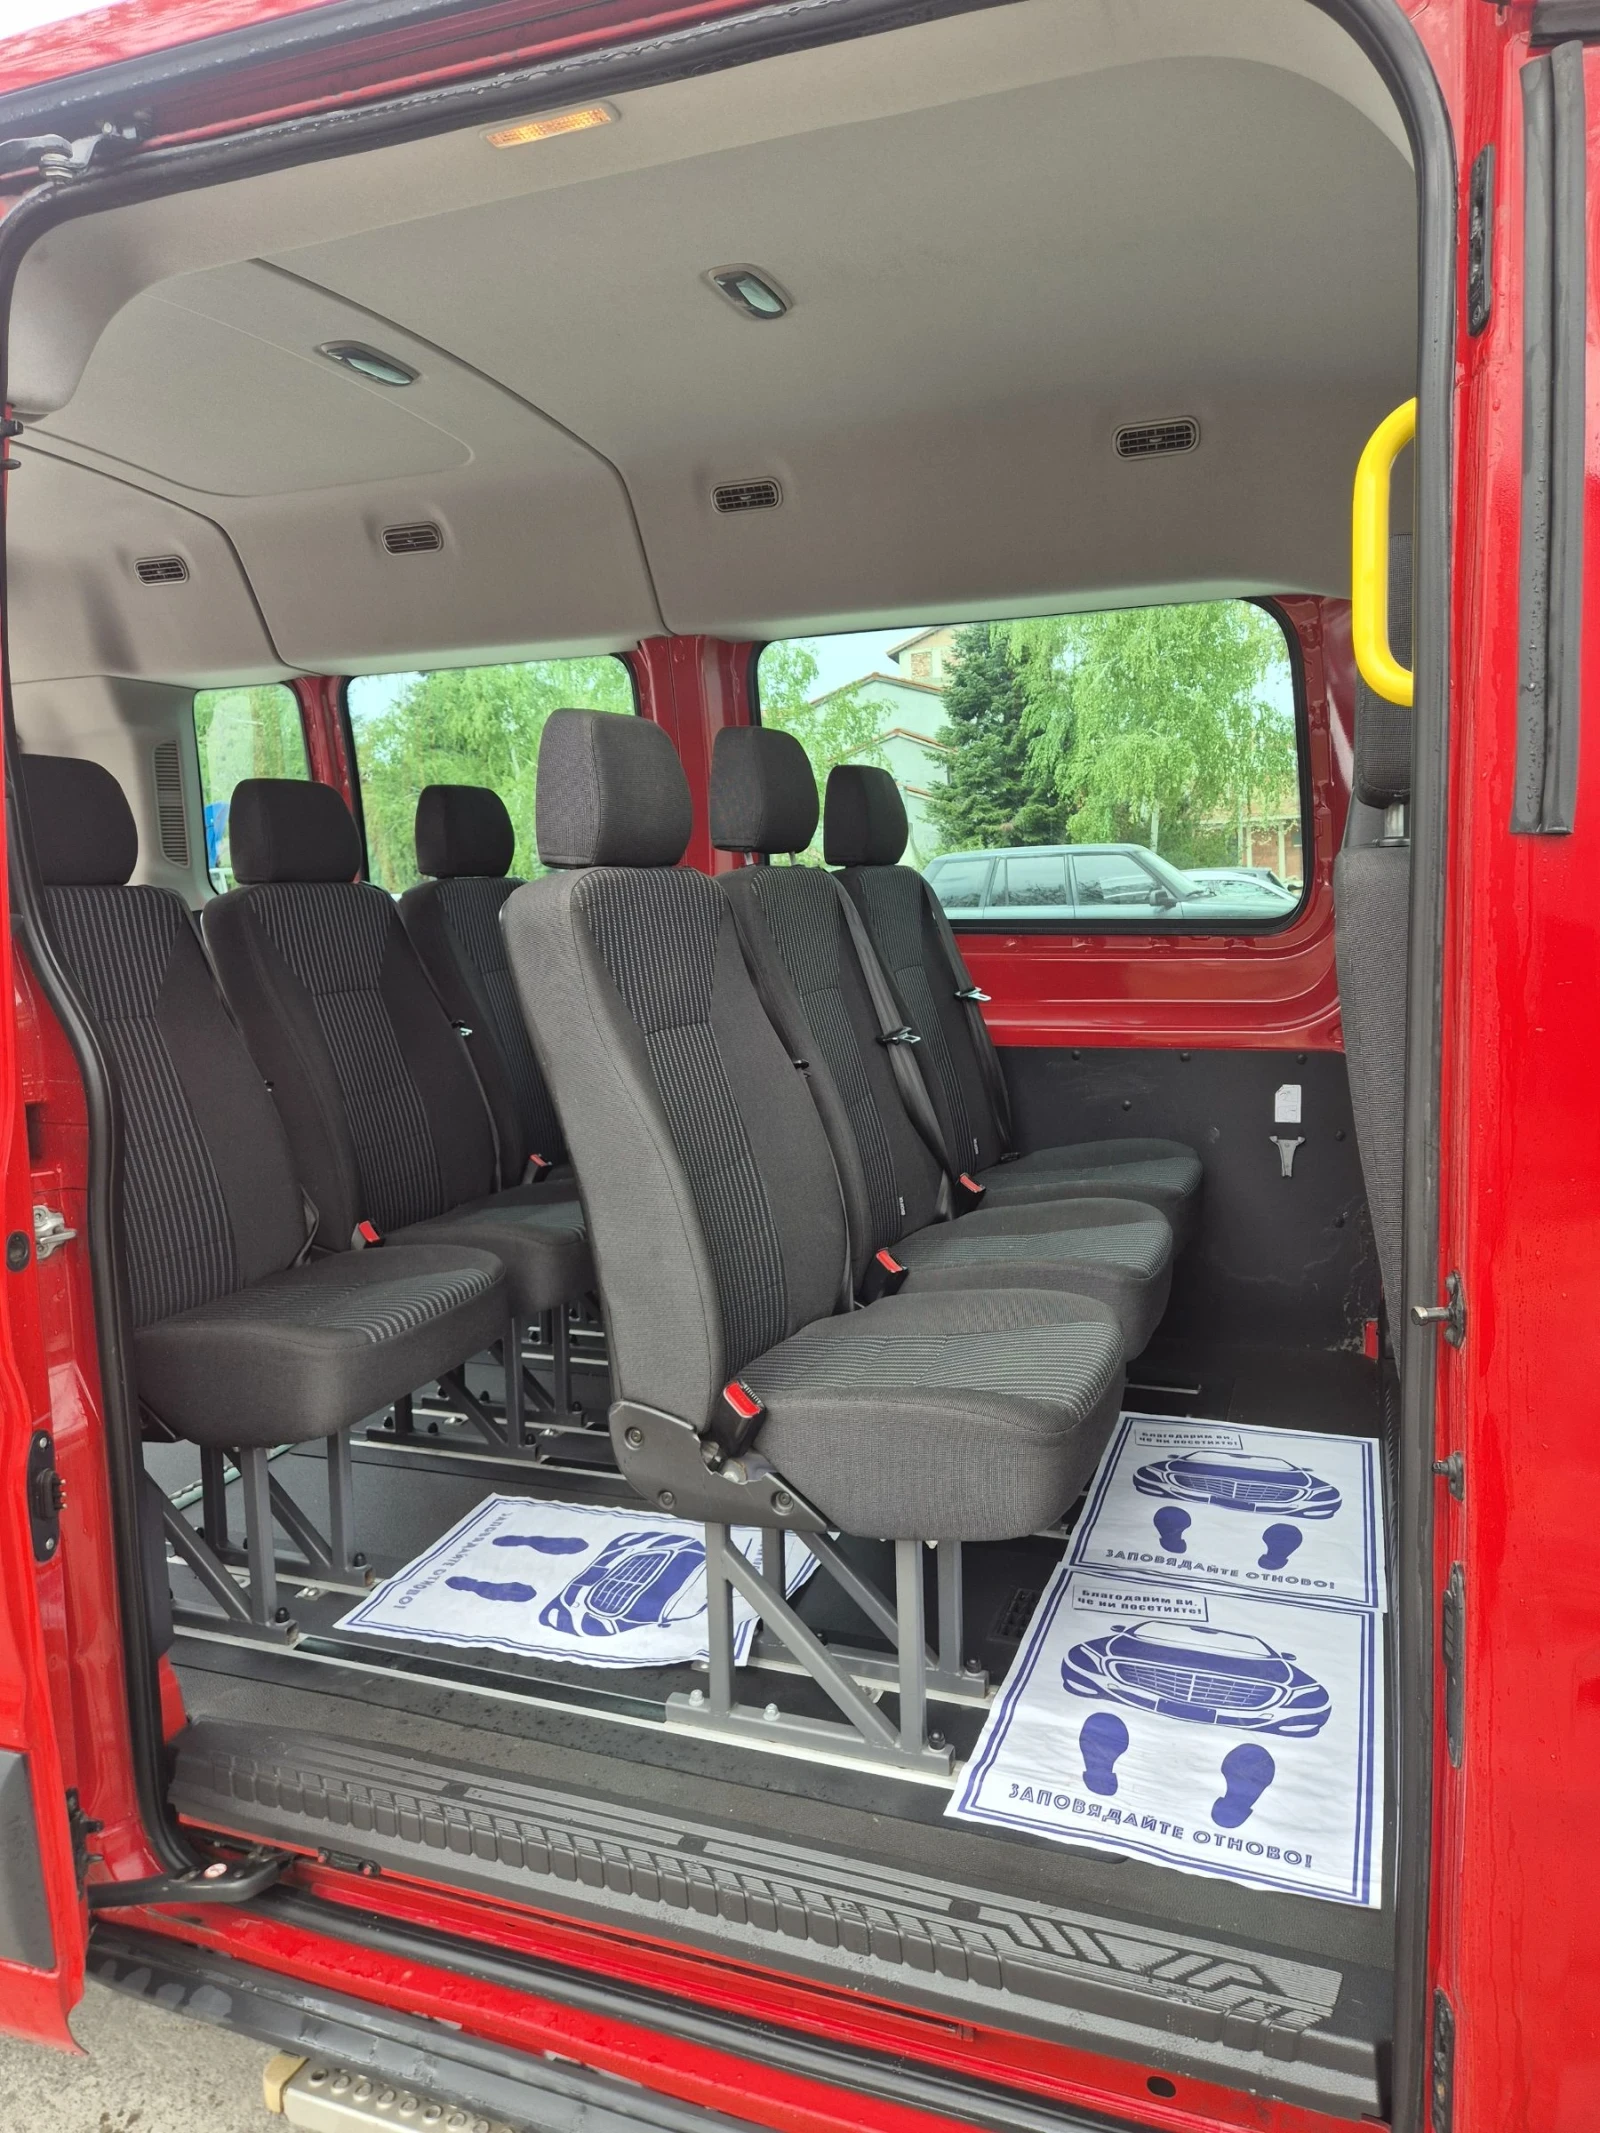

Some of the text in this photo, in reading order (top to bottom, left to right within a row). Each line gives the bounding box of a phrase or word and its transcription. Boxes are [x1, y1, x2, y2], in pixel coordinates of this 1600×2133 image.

[1105, 1548, 1335, 1589] ЗАПОВЯДАЙТЕ ОТНОВО!
[1077, 1597, 1202, 1615] че ни посетихте!
[1081, 1589, 1171, 1604] Благодарим
[1008, 1782, 1313, 1869] ЗАПОВЯДАЙТЕ ОТНОВО!
